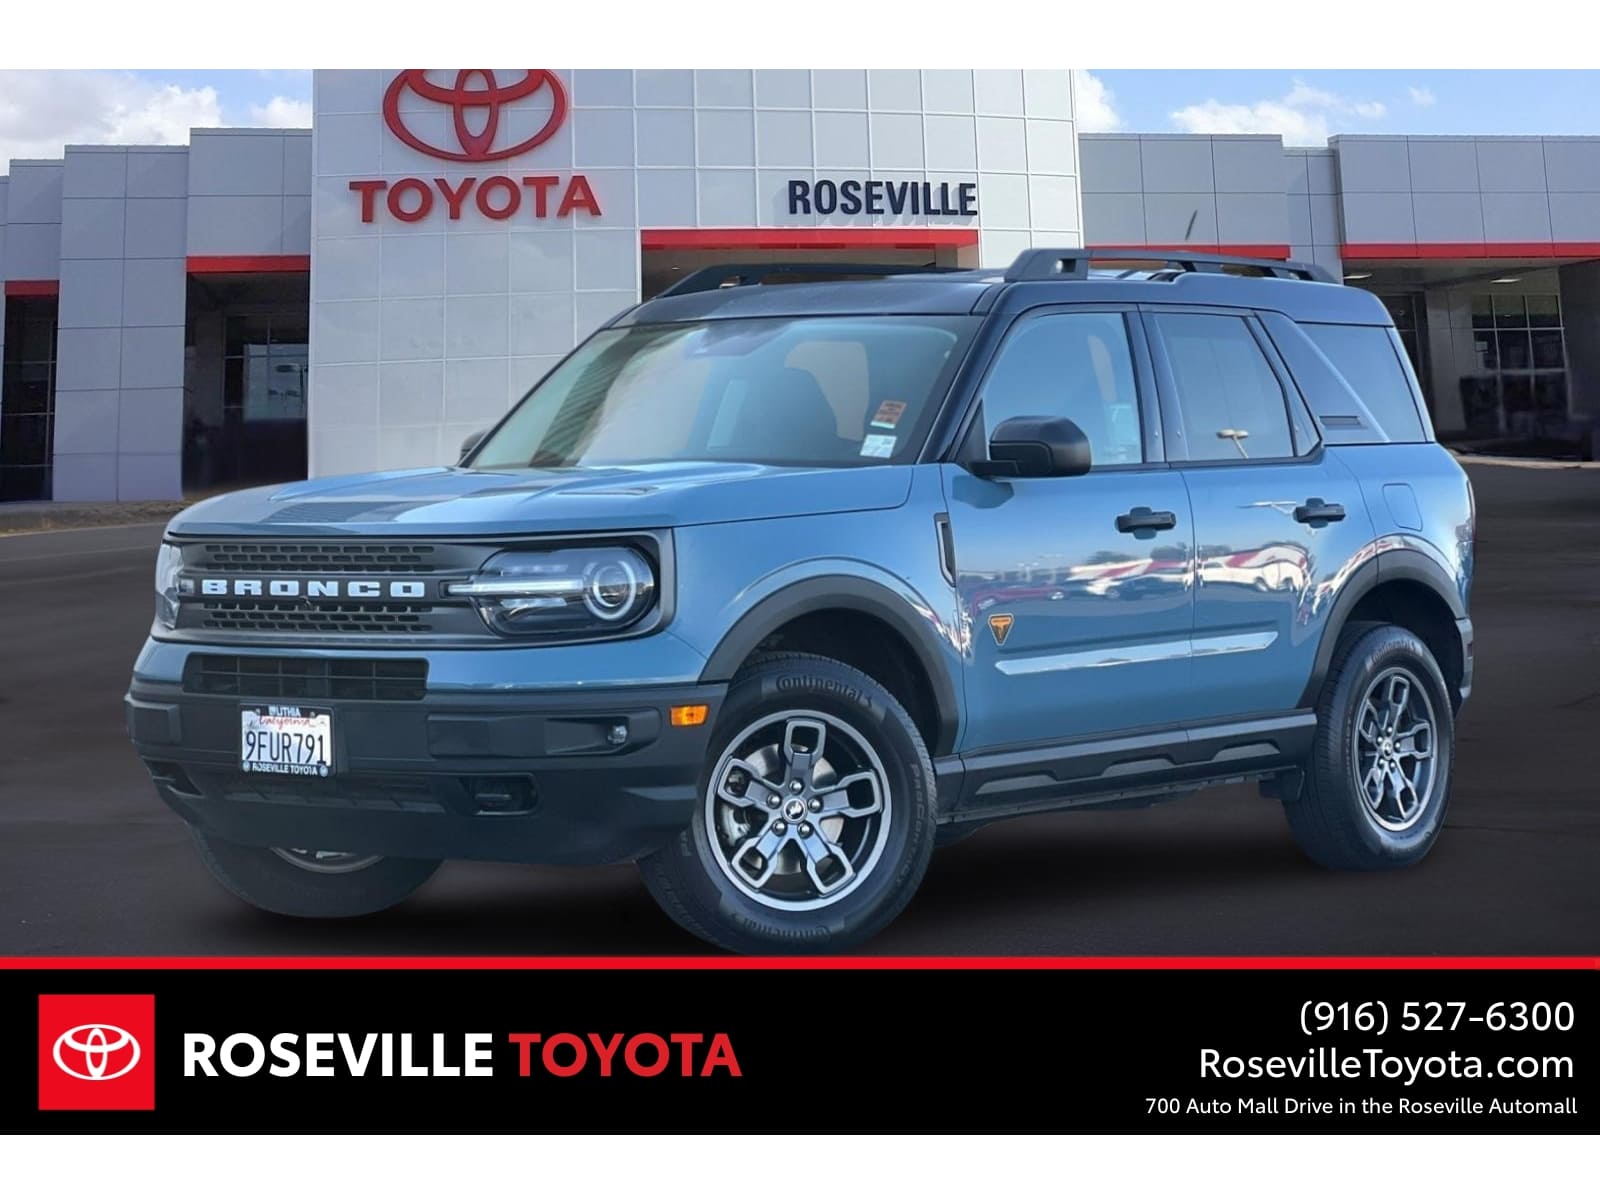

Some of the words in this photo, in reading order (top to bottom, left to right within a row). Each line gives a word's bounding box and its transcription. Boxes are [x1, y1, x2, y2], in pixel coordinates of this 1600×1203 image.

[349, 175, 602, 224] TOYOTA
[787, 179, 979, 217] ROSEVILLE
[203, 579, 425, 597] BRONCO
[776, 675, 861, 704] Continental
[246, 731, 326, 764] 9FUR791
[252, 763, 289, 773] ROSEVILLE
[290, 765, 318, 775] TOYOTA
